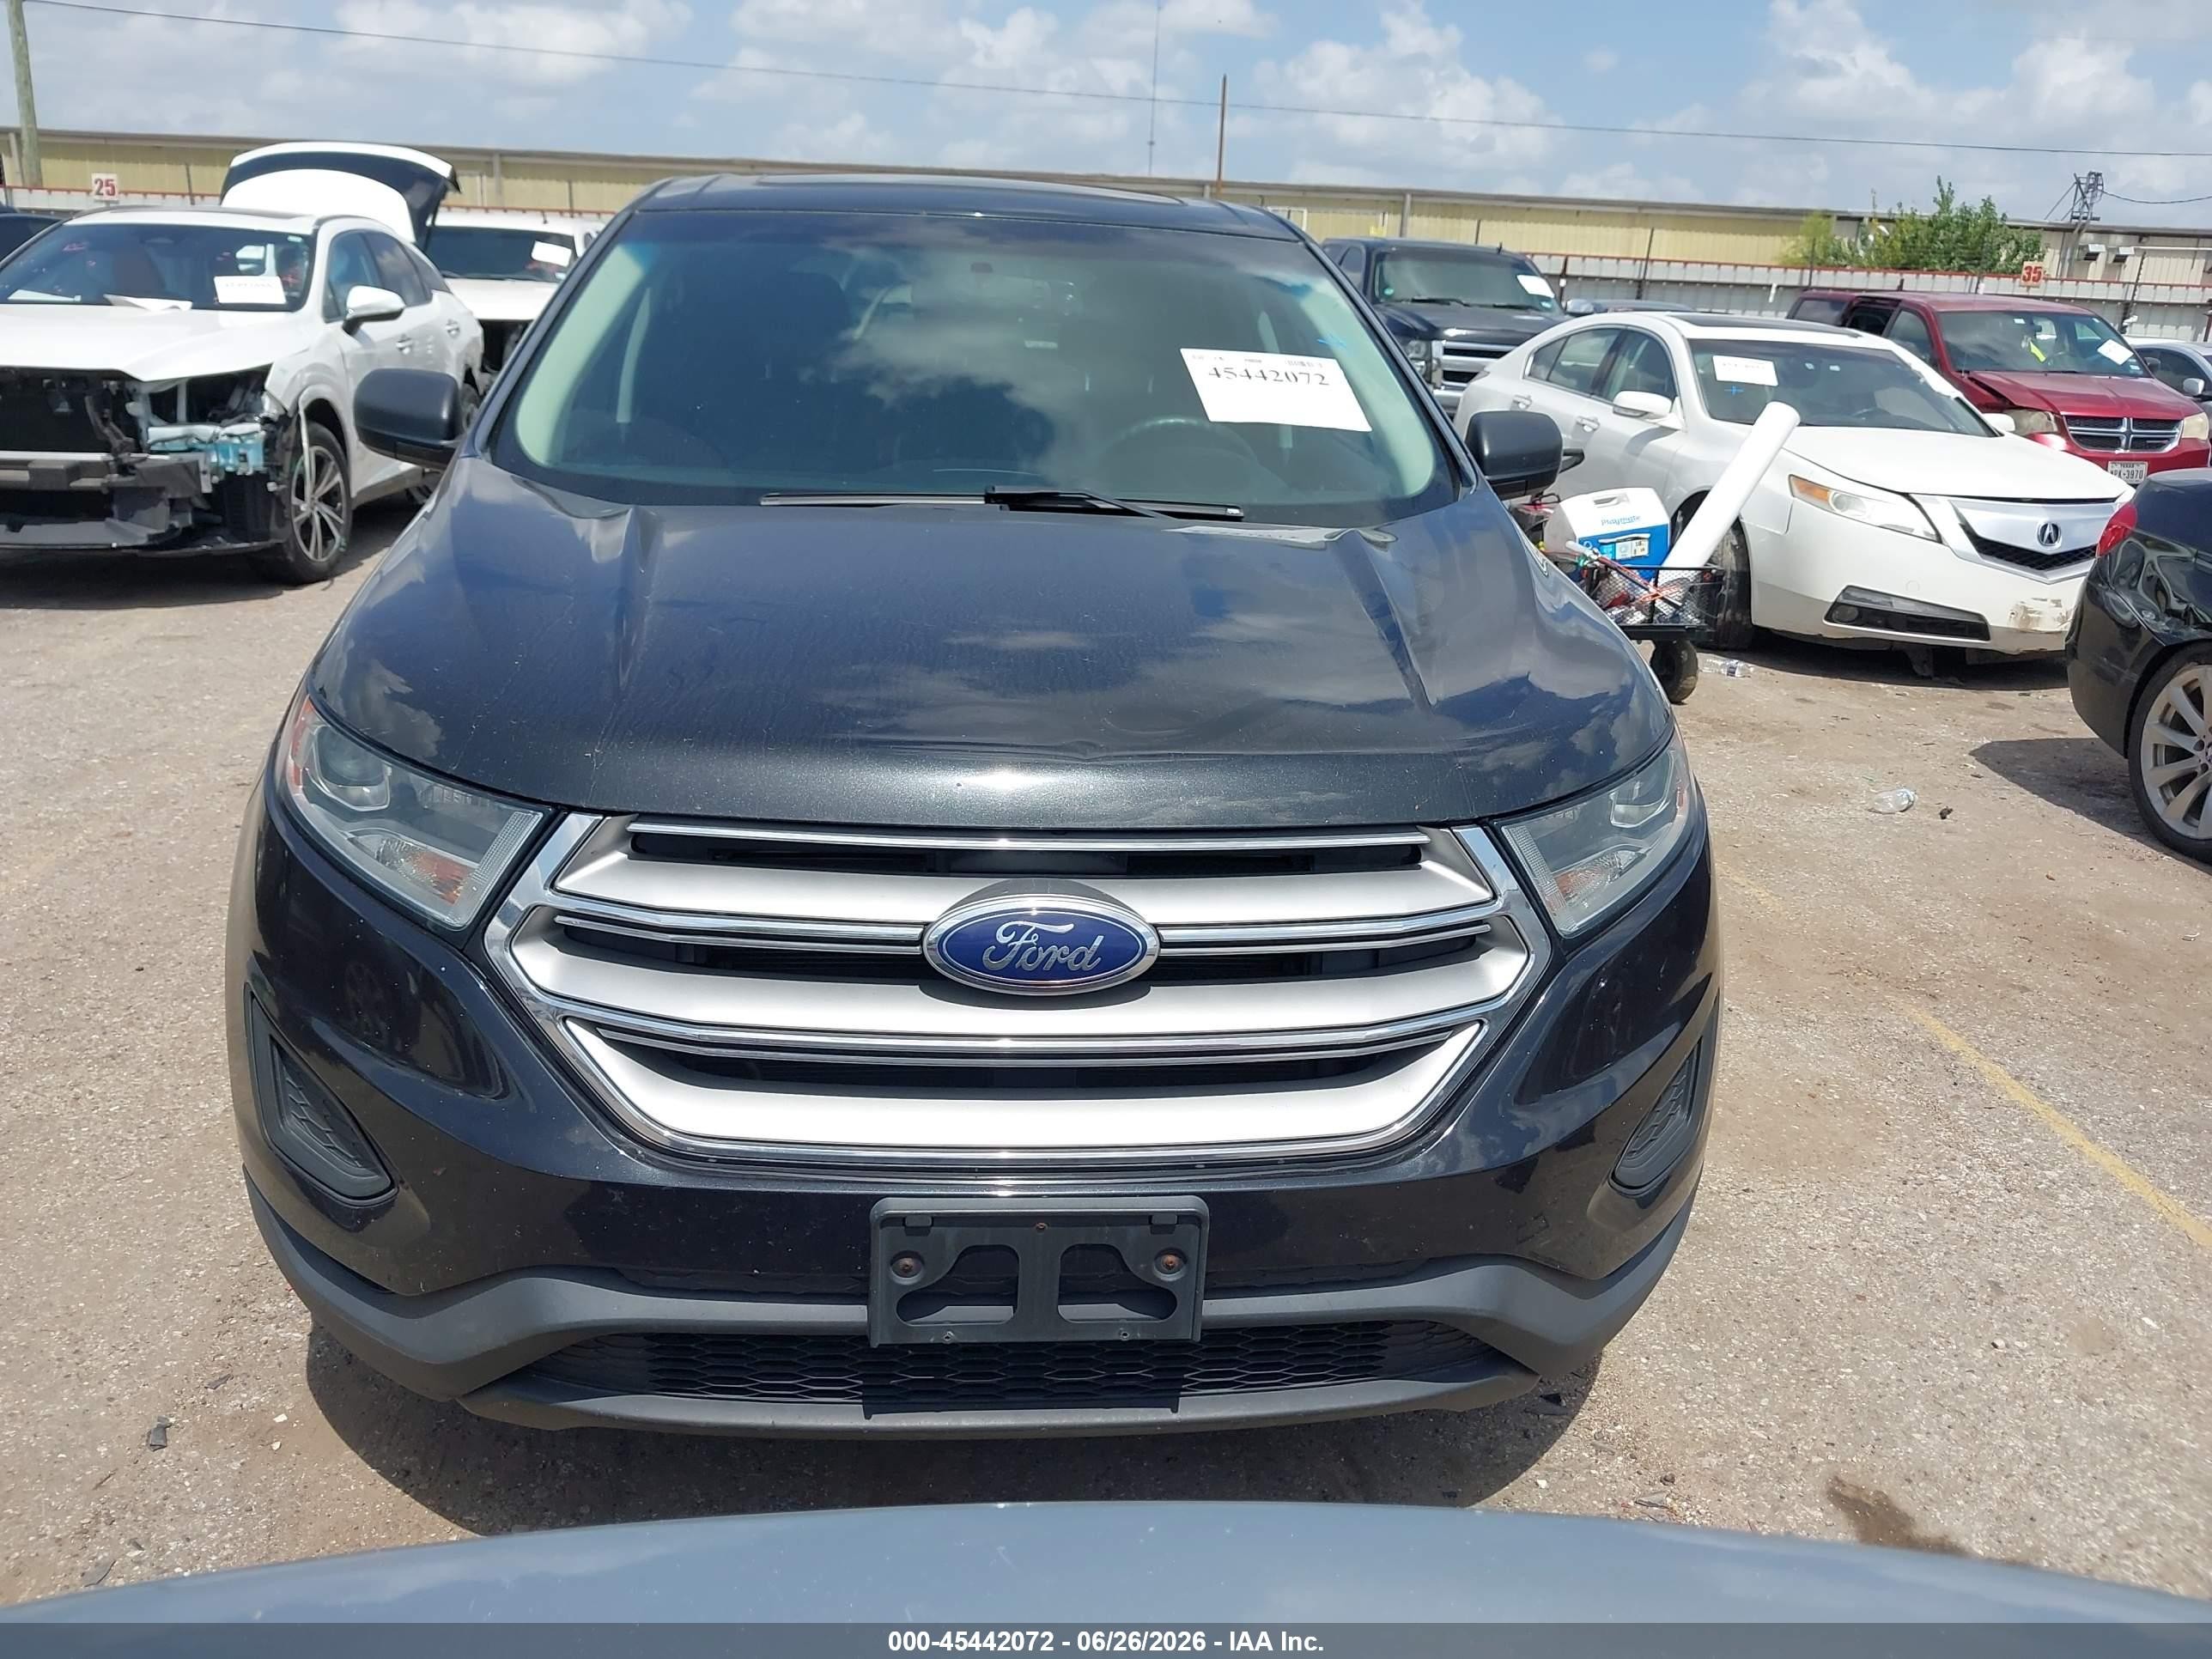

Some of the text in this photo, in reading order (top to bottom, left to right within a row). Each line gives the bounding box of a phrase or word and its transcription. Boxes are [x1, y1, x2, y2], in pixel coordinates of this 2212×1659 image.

[94, 178, 116, 197] 25
[2022, 265, 2043, 283] 35
[1208, 367, 1330, 386] 45442072
[981, 921, 1104, 971] Ford
